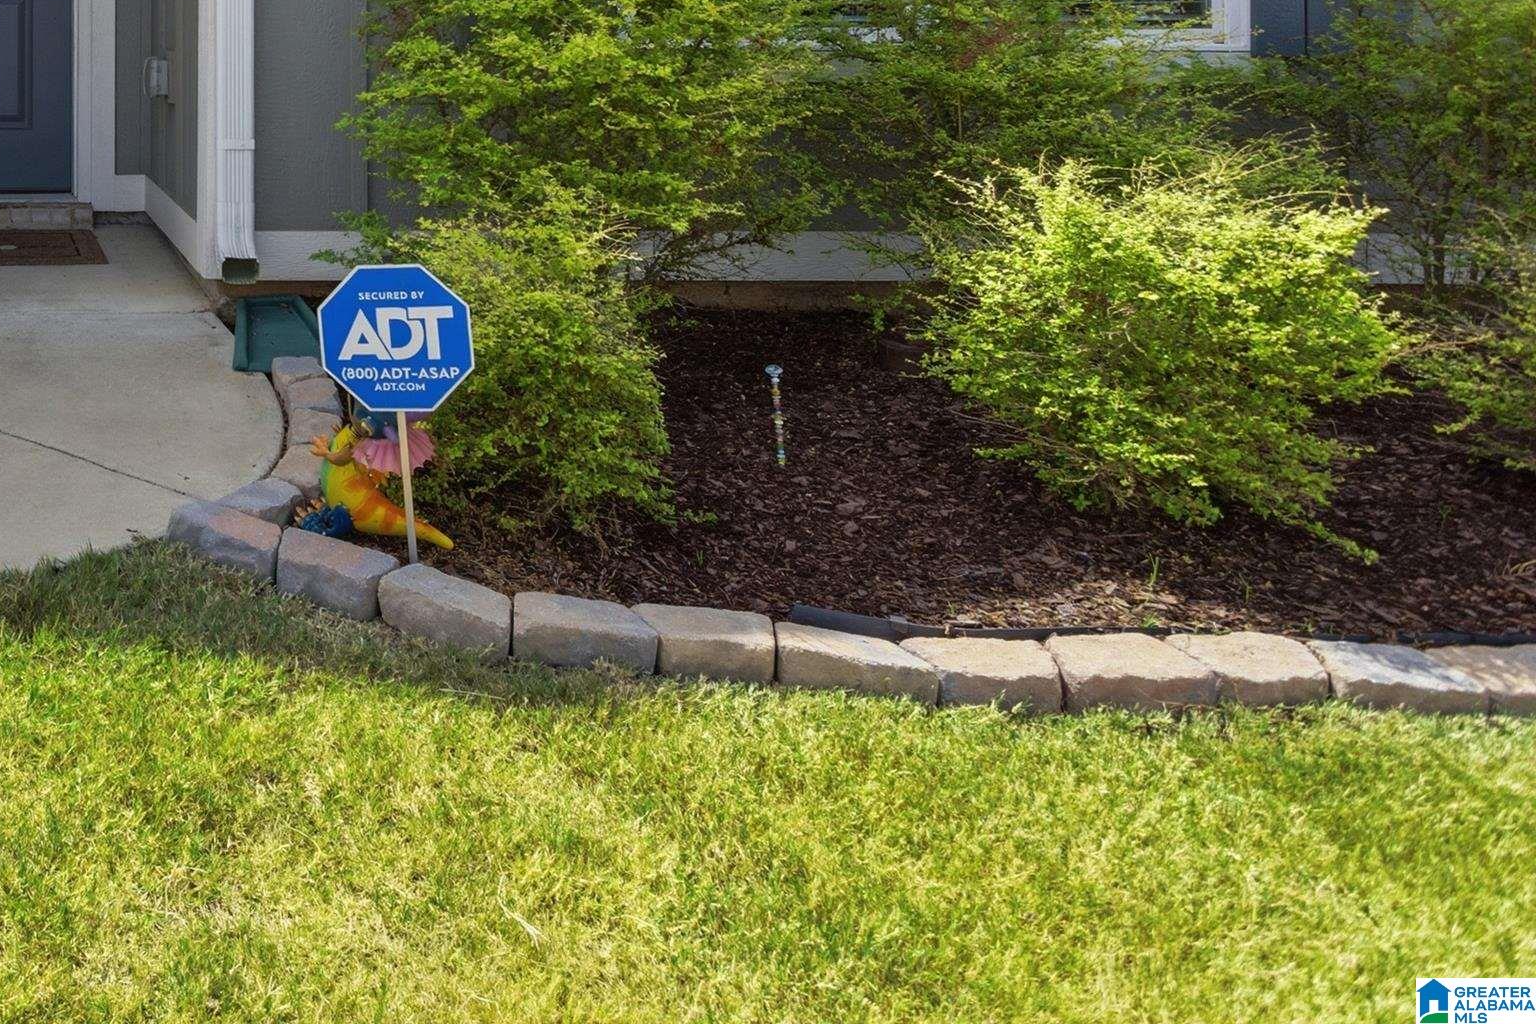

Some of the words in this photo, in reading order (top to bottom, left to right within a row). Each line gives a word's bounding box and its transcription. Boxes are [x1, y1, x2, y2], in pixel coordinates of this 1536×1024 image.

[358, 291, 408, 301] SECURED
[411, 291, 424, 300] BY
[338, 306, 454, 361] ADT
[341, 367, 378, 381] (800)
[380, 367, 460, 379] ADT-ASAP
[374, 382, 426, 392] ADT.COM
